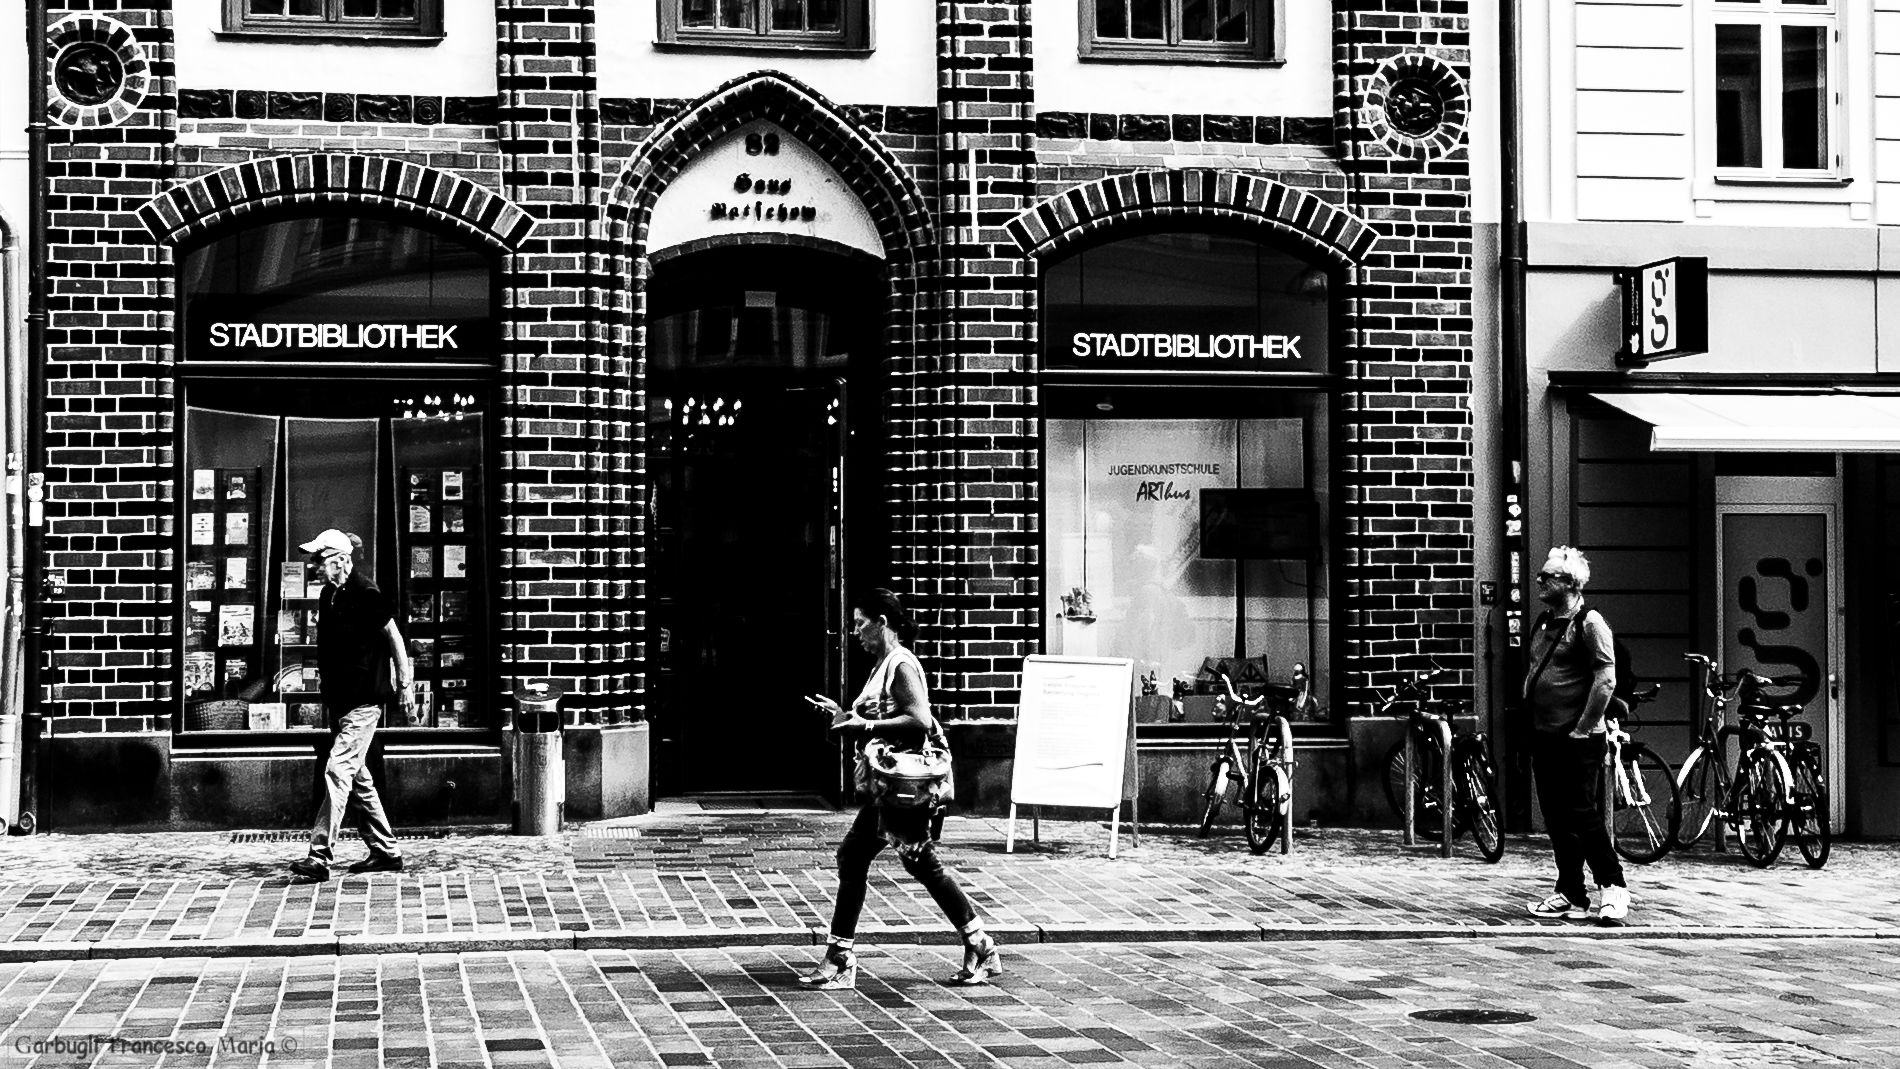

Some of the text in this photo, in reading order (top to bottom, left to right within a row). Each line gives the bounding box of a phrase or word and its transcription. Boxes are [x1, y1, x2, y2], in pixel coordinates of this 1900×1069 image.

[745, 132, 780, 157] 82
[209, 322, 458, 349] STADTBIBLIOTHEK
[1072, 333, 1302, 358] STADTBIBLIOTHEK
[1108, 463, 1221, 476] JUGENDKUNSTSCHULE
